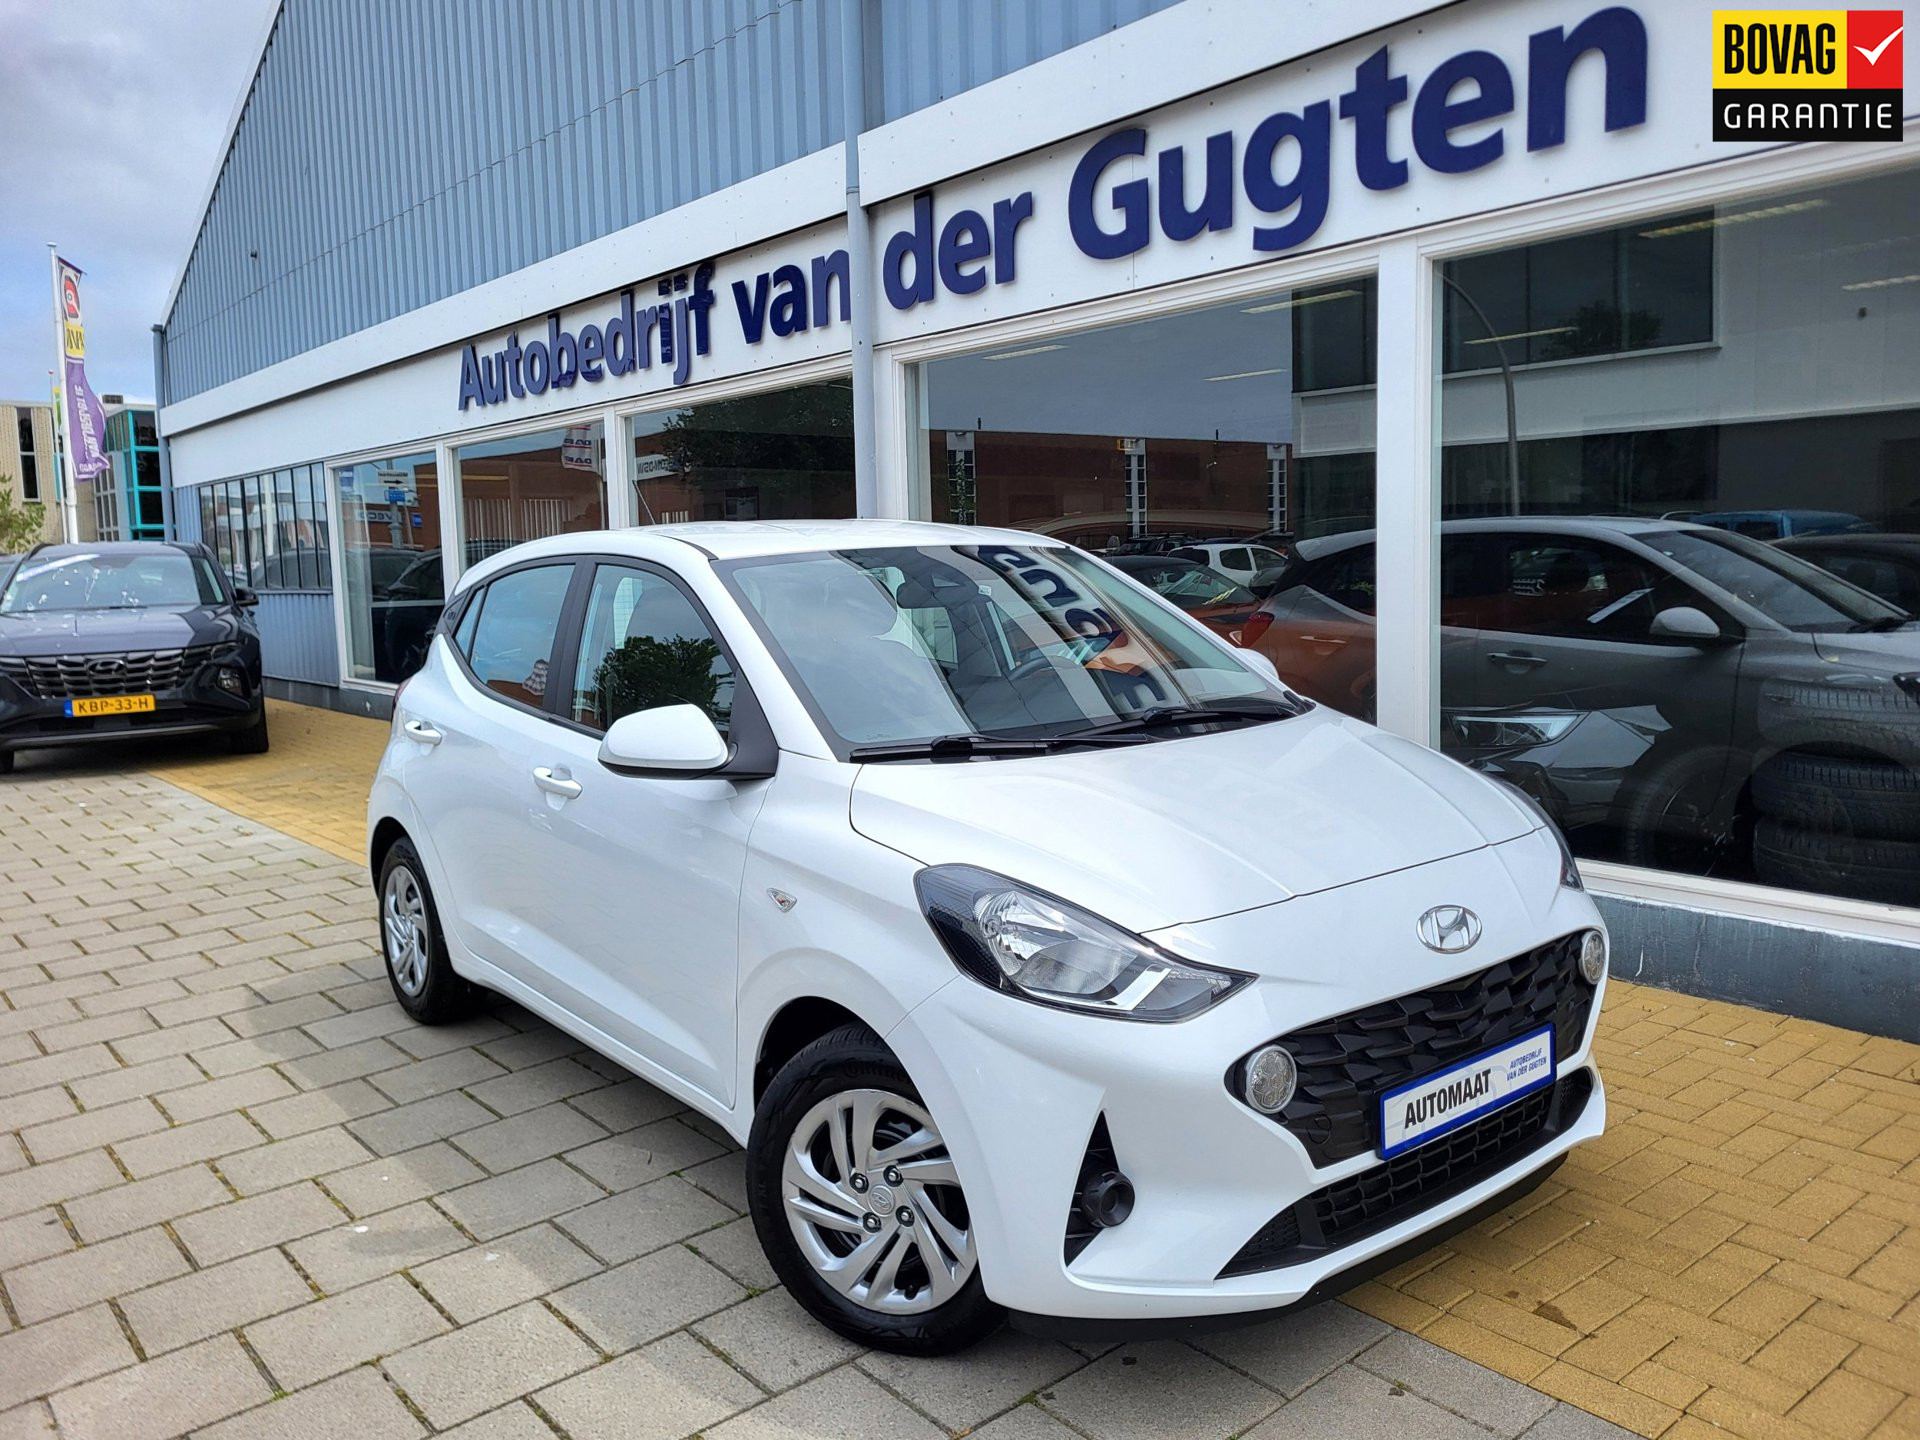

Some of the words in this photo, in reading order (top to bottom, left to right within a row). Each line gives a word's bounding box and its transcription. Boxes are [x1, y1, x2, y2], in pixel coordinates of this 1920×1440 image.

[459, 261, 714, 410] Autobedrijf
[732, 249, 851, 344] van
[883, 192, 1032, 310] der
[1068, 6, 1648, 260] Gugten
[78, 697, 149, 714] KBP-33-H
[1506, 1070, 1517, 1081] VAN
[1517, 1065, 1528, 1077] DER
[1528, 1056, 1547, 1072] GUGTEN
[1510, 1047, 1543, 1069] AUTOBEDRIJF
[1404, 1068, 1491, 1129] AUTOMAAT
